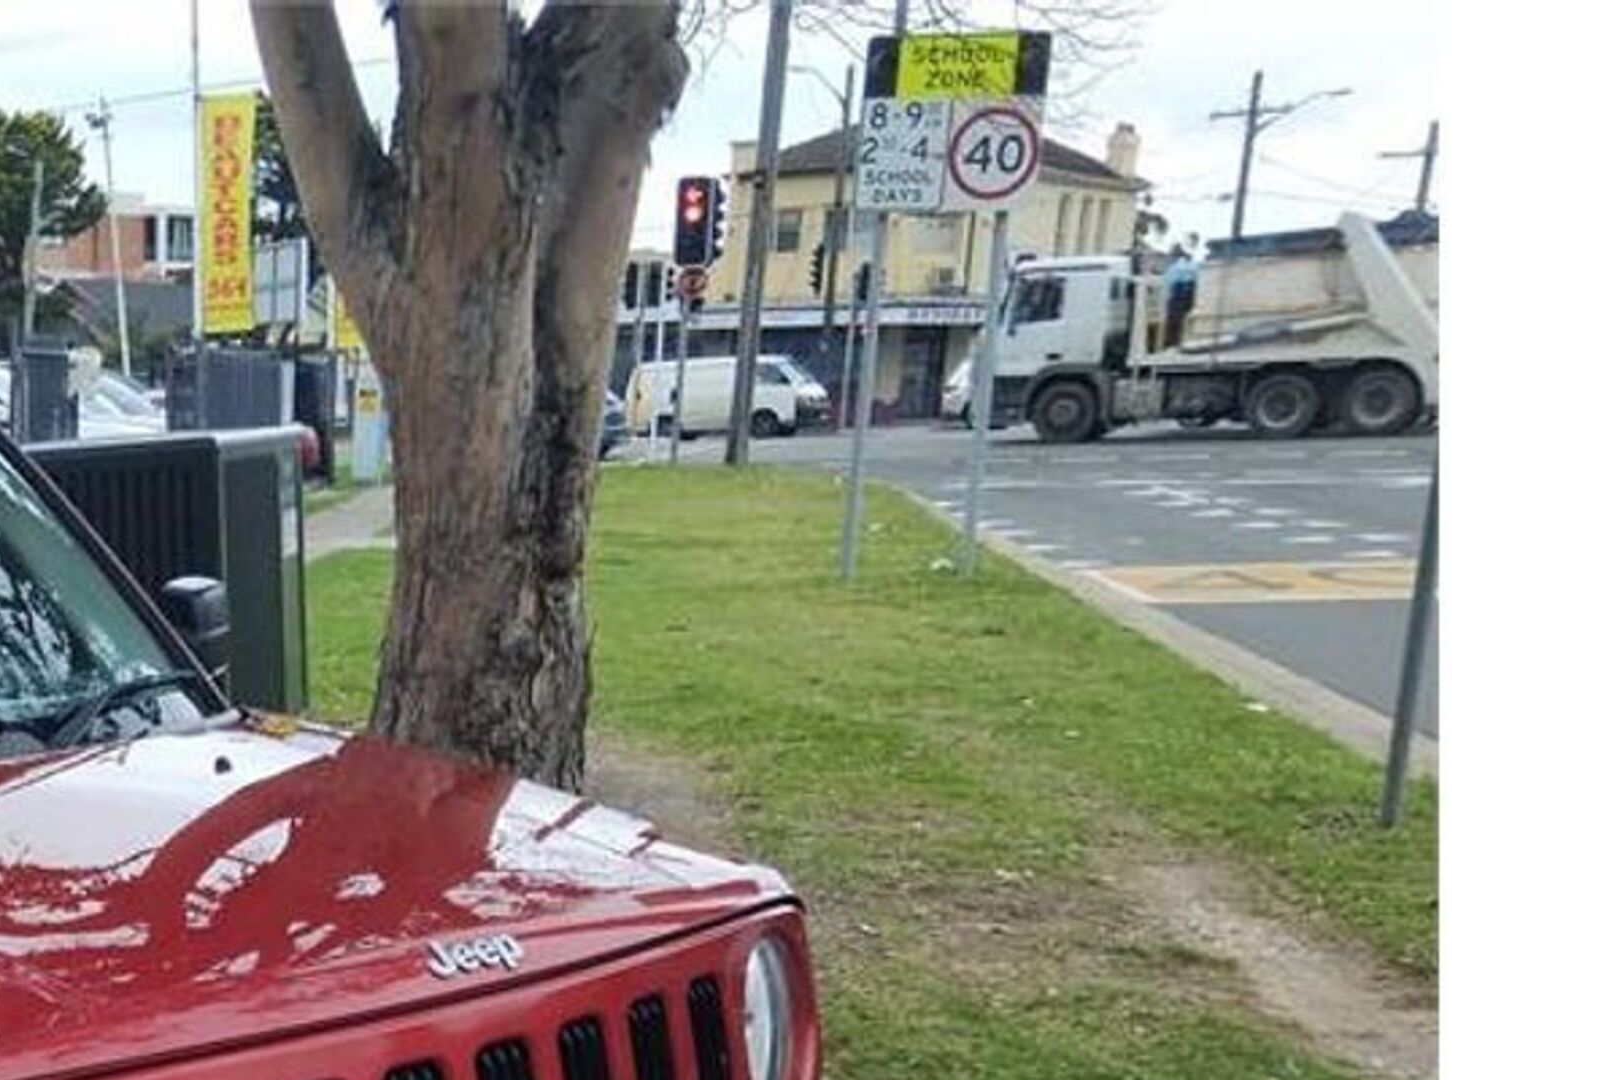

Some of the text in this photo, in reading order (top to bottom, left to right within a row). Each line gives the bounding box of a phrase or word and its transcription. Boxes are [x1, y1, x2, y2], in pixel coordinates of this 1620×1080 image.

[908, 42, 1005, 64] SCHOOL
[925, 69, 987, 88] ZONE
[963, 134, 1026, 173] 40
[864, 169, 931, 185] SCHOOL
[873, 188, 922, 202] DAYS
[426, 934, 523, 975] Jeep
